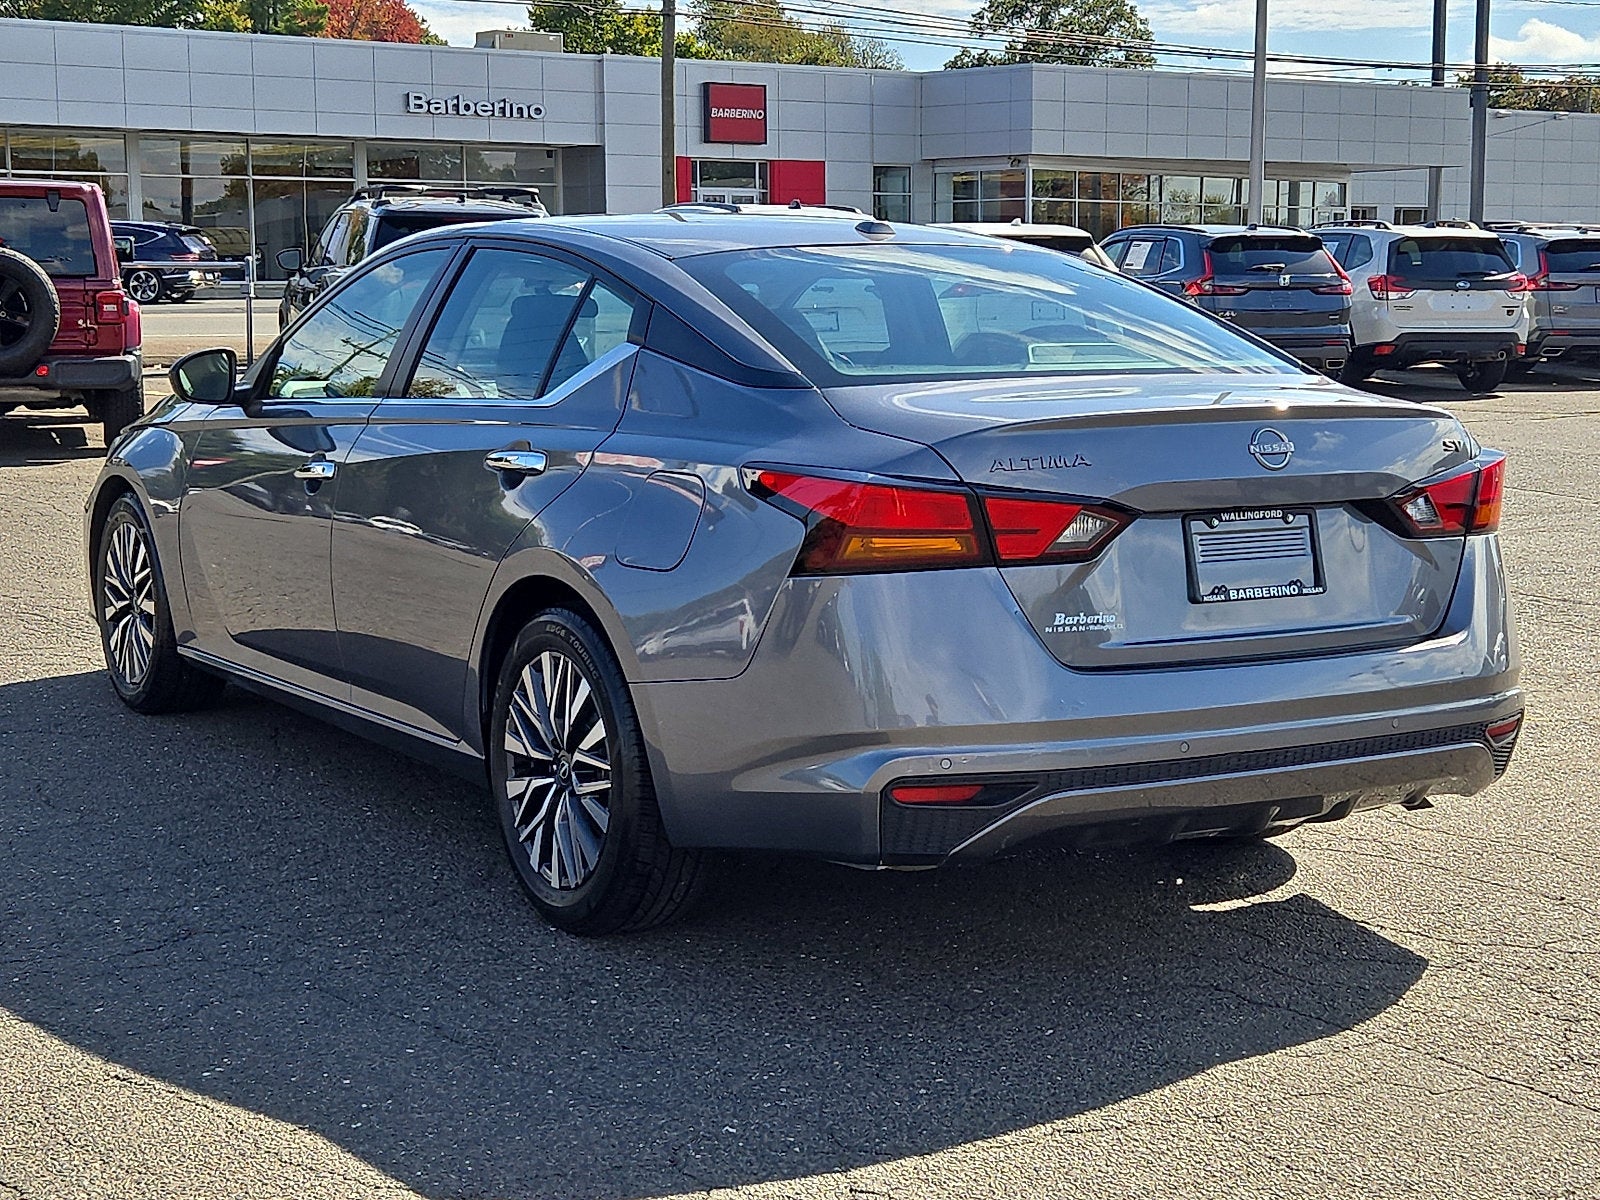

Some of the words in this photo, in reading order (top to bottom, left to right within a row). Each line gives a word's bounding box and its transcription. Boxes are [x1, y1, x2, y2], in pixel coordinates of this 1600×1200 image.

[406, 91, 546, 119] Barberino
[711, 107, 765, 120] BARBERINO
[1249, 442, 1295, 454] NISSAN
[1442, 440, 1464, 452] SV
[989, 454, 1093, 473] ALTIMA
[1220, 509, 1283, 522] WALLINGFORD
[1202, 593, 1226, 602] NISSAN
[1229, 584, 1299, 601] BARBERINO
[1302, 586, 1324, 595] NISSAN
[1053, 611, 1117, 626] Barberino
[1044, 625, 1086, 633] NISSAN
